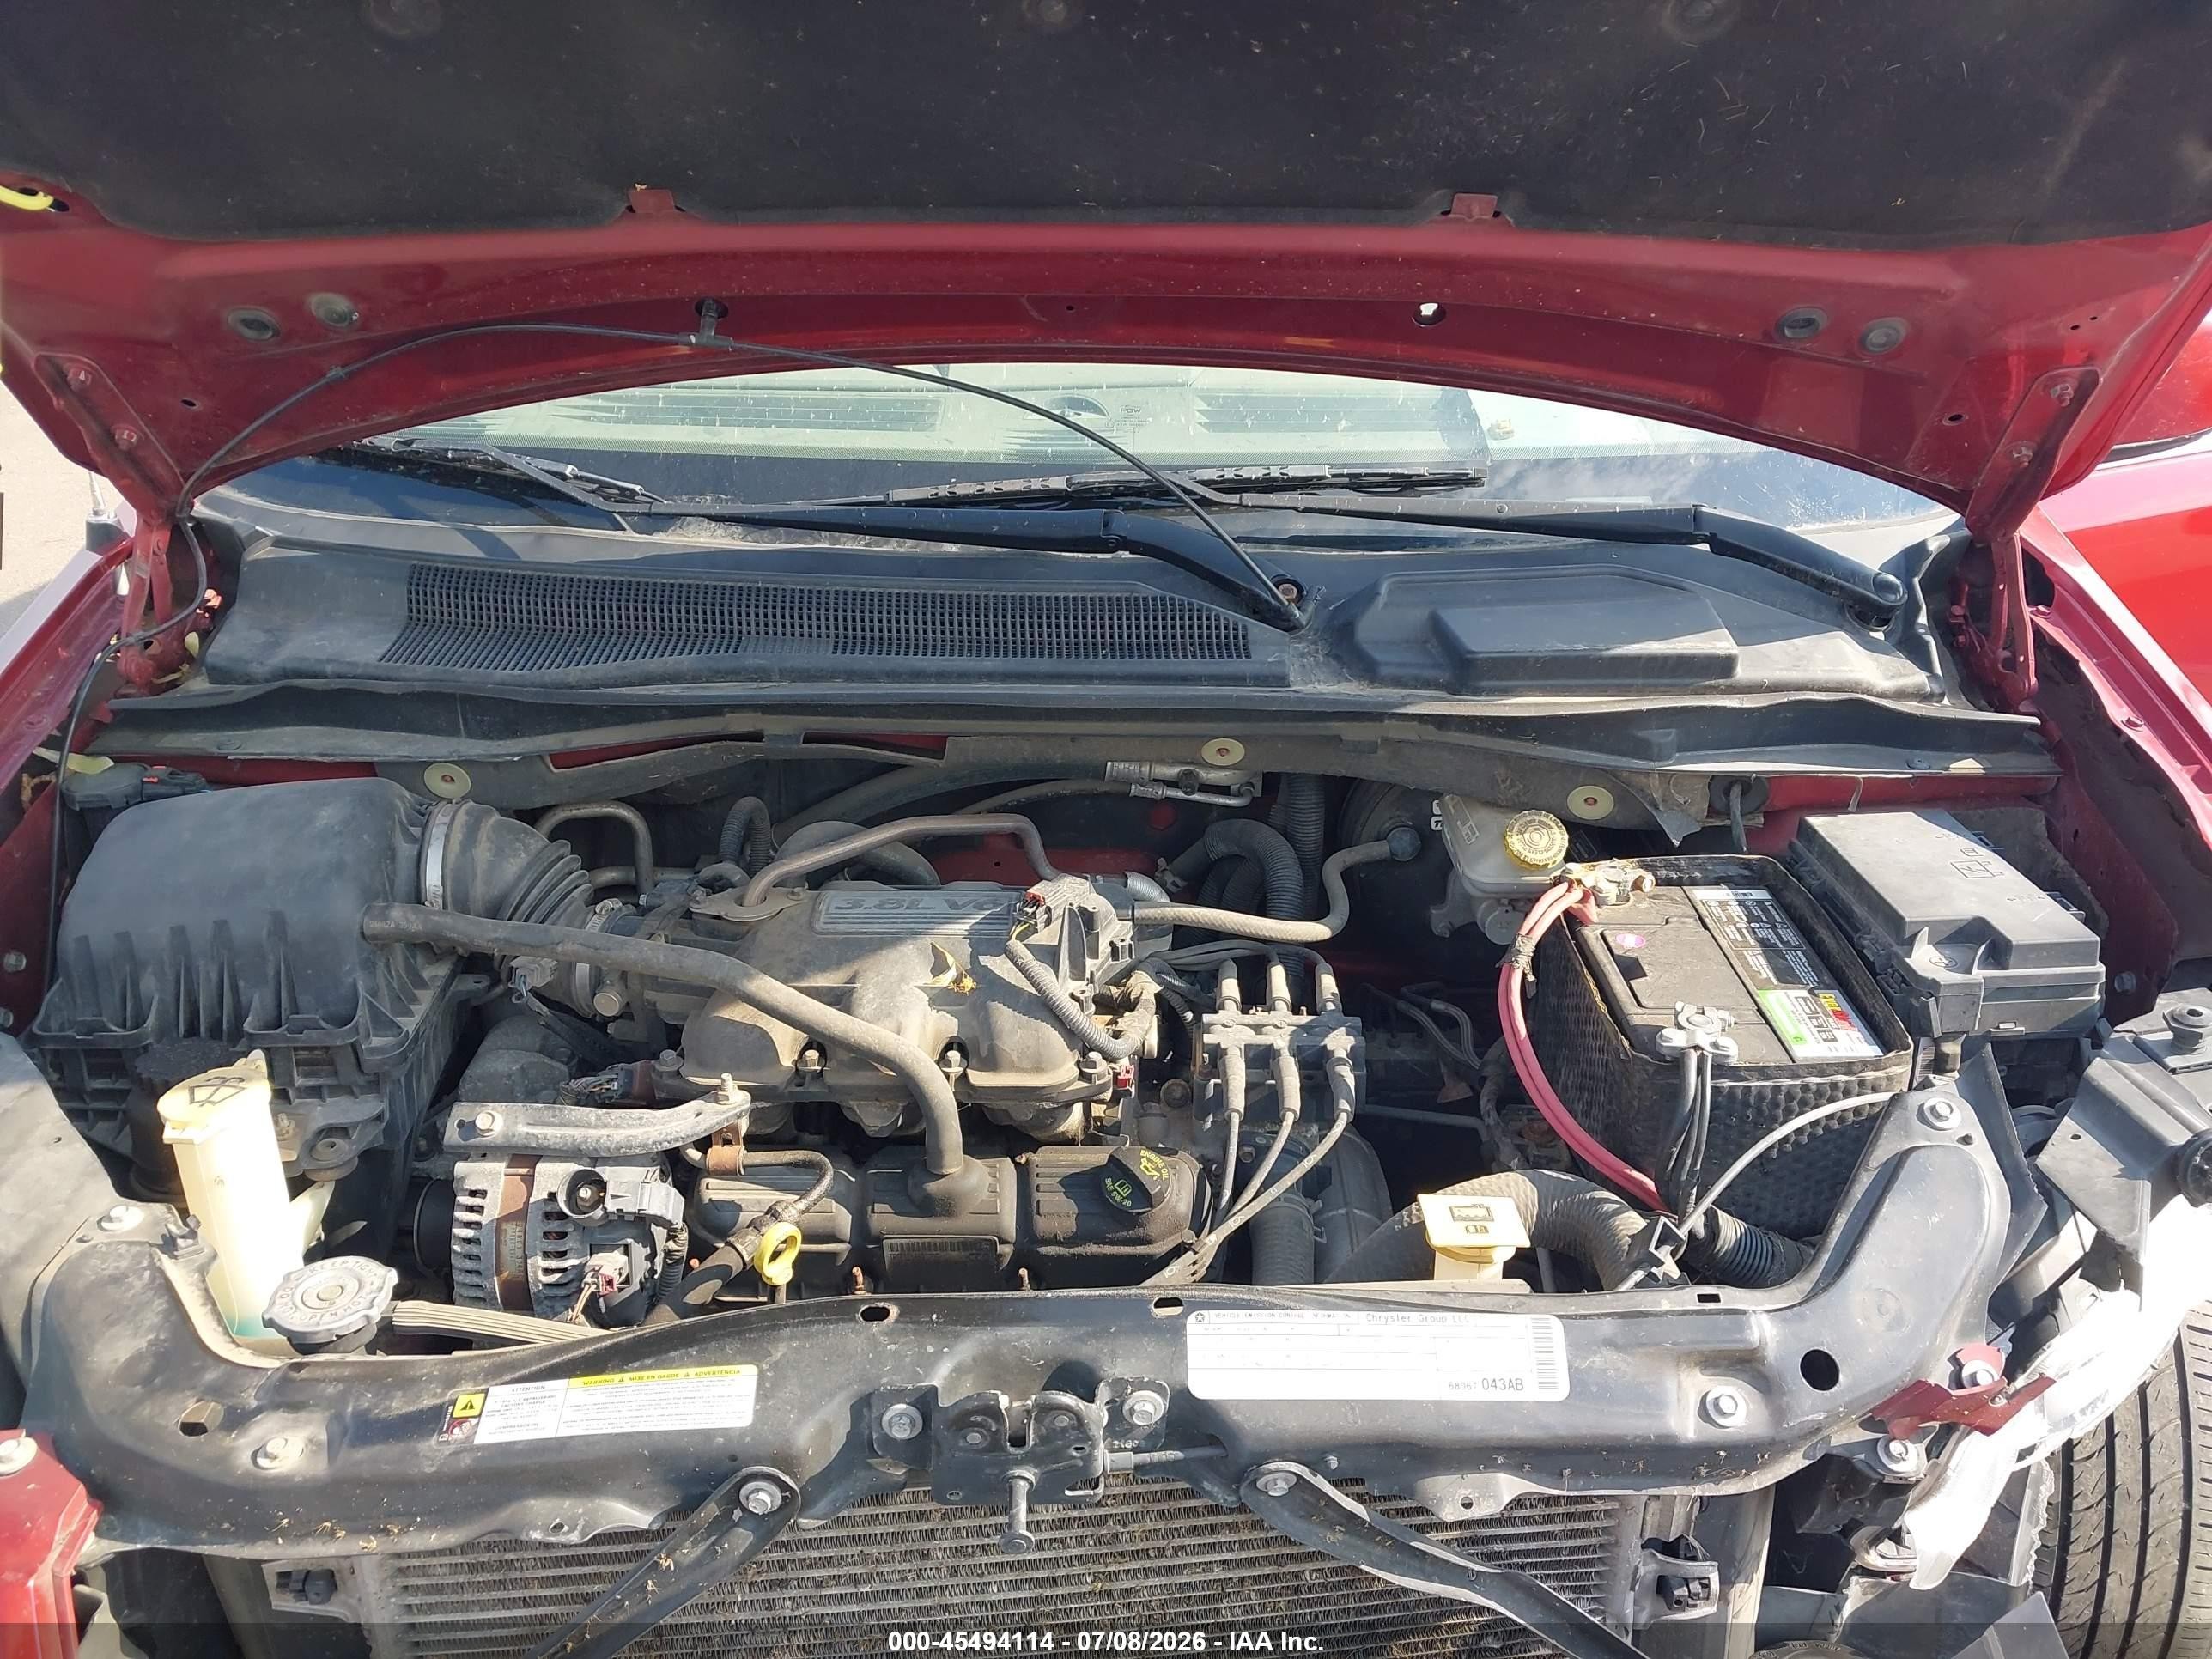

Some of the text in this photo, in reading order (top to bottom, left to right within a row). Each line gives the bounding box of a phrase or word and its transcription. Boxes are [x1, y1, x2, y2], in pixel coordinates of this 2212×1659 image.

[834, 897, 1002, 911] 3.8L V6
[1140, 1149, 1170, 1181] ENGINE OIL
[1104, 1177, 1115, 1191] SAE
[1365, 1313, 1469, 1324] Chrysler Group LLC
[1481, 1377, 1524, 1391] 043AB
